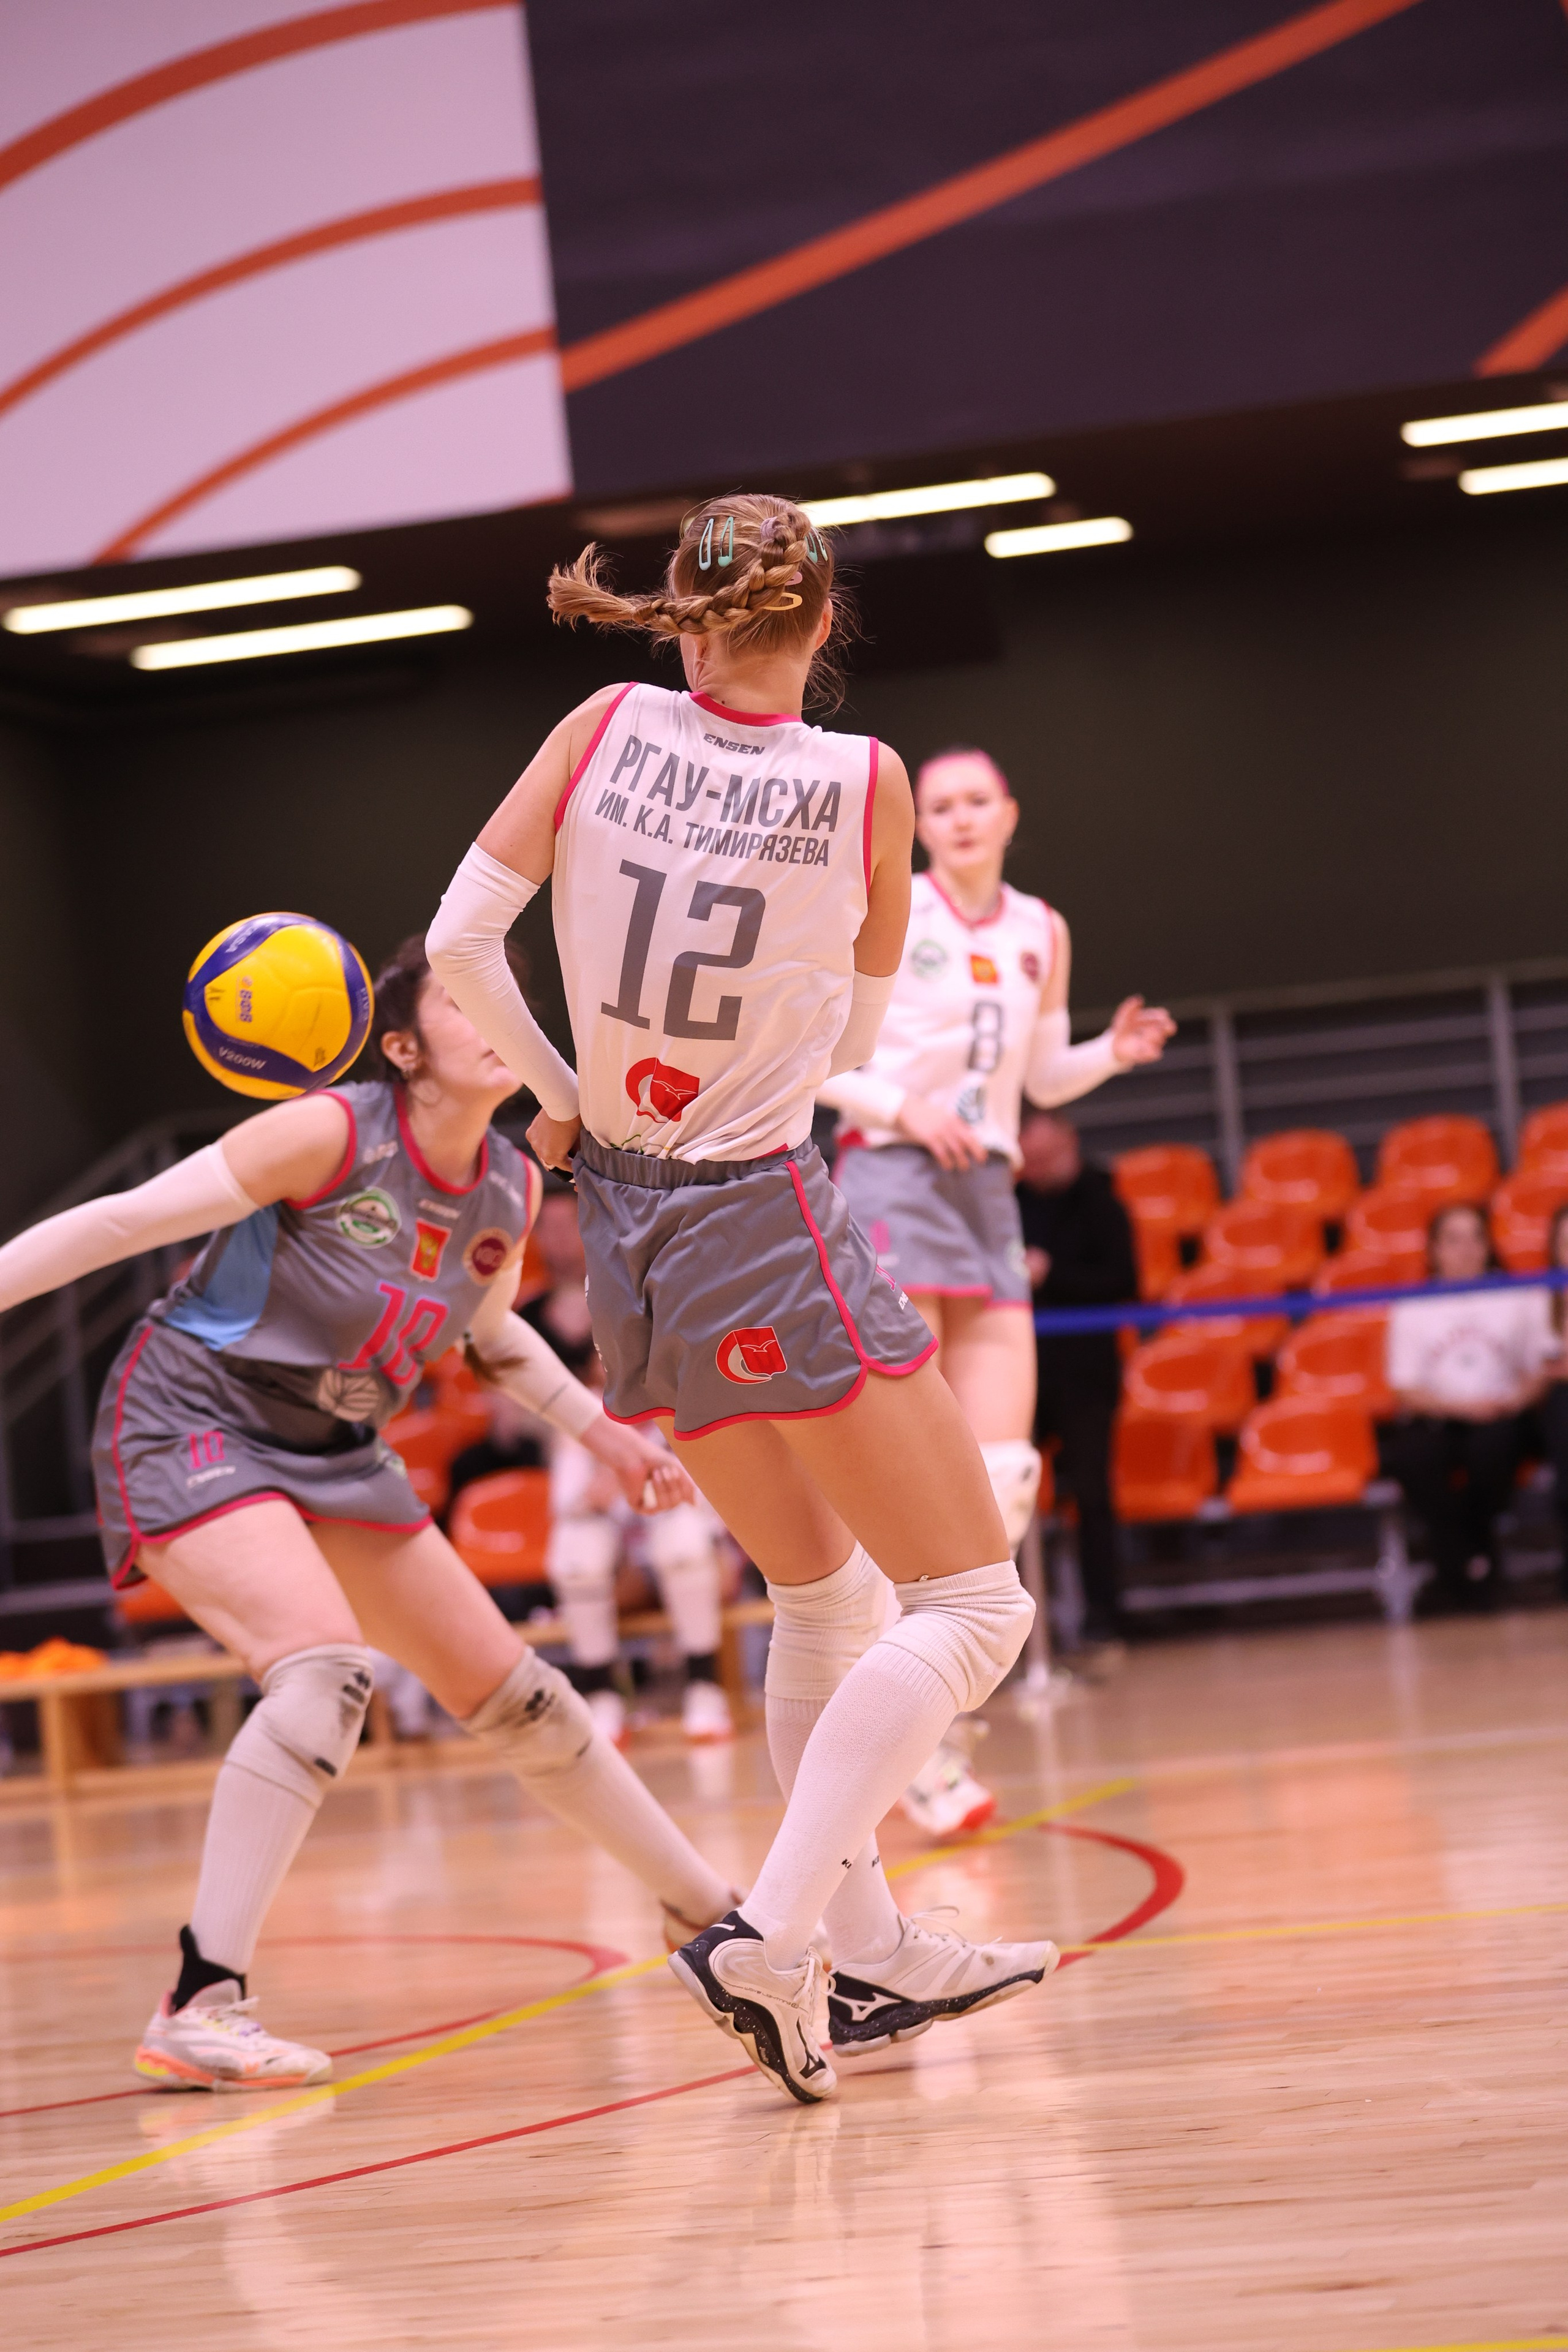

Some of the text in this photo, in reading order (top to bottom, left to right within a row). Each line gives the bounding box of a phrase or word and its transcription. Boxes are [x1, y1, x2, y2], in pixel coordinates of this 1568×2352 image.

[704, 733, 765, 755] ENSEN
[609, 734, 842, 832] РГАУ-МСХА
[595, 789, 829, 867] ИМ. К.А. ТИМИРЯЗЕВА
[601, 859, 766, 1041] 12
[218, 1046, 267, 1070] V200W
[968, 1000, 1003, 1075] 8
[189, 1430, 225, 1469] 10
